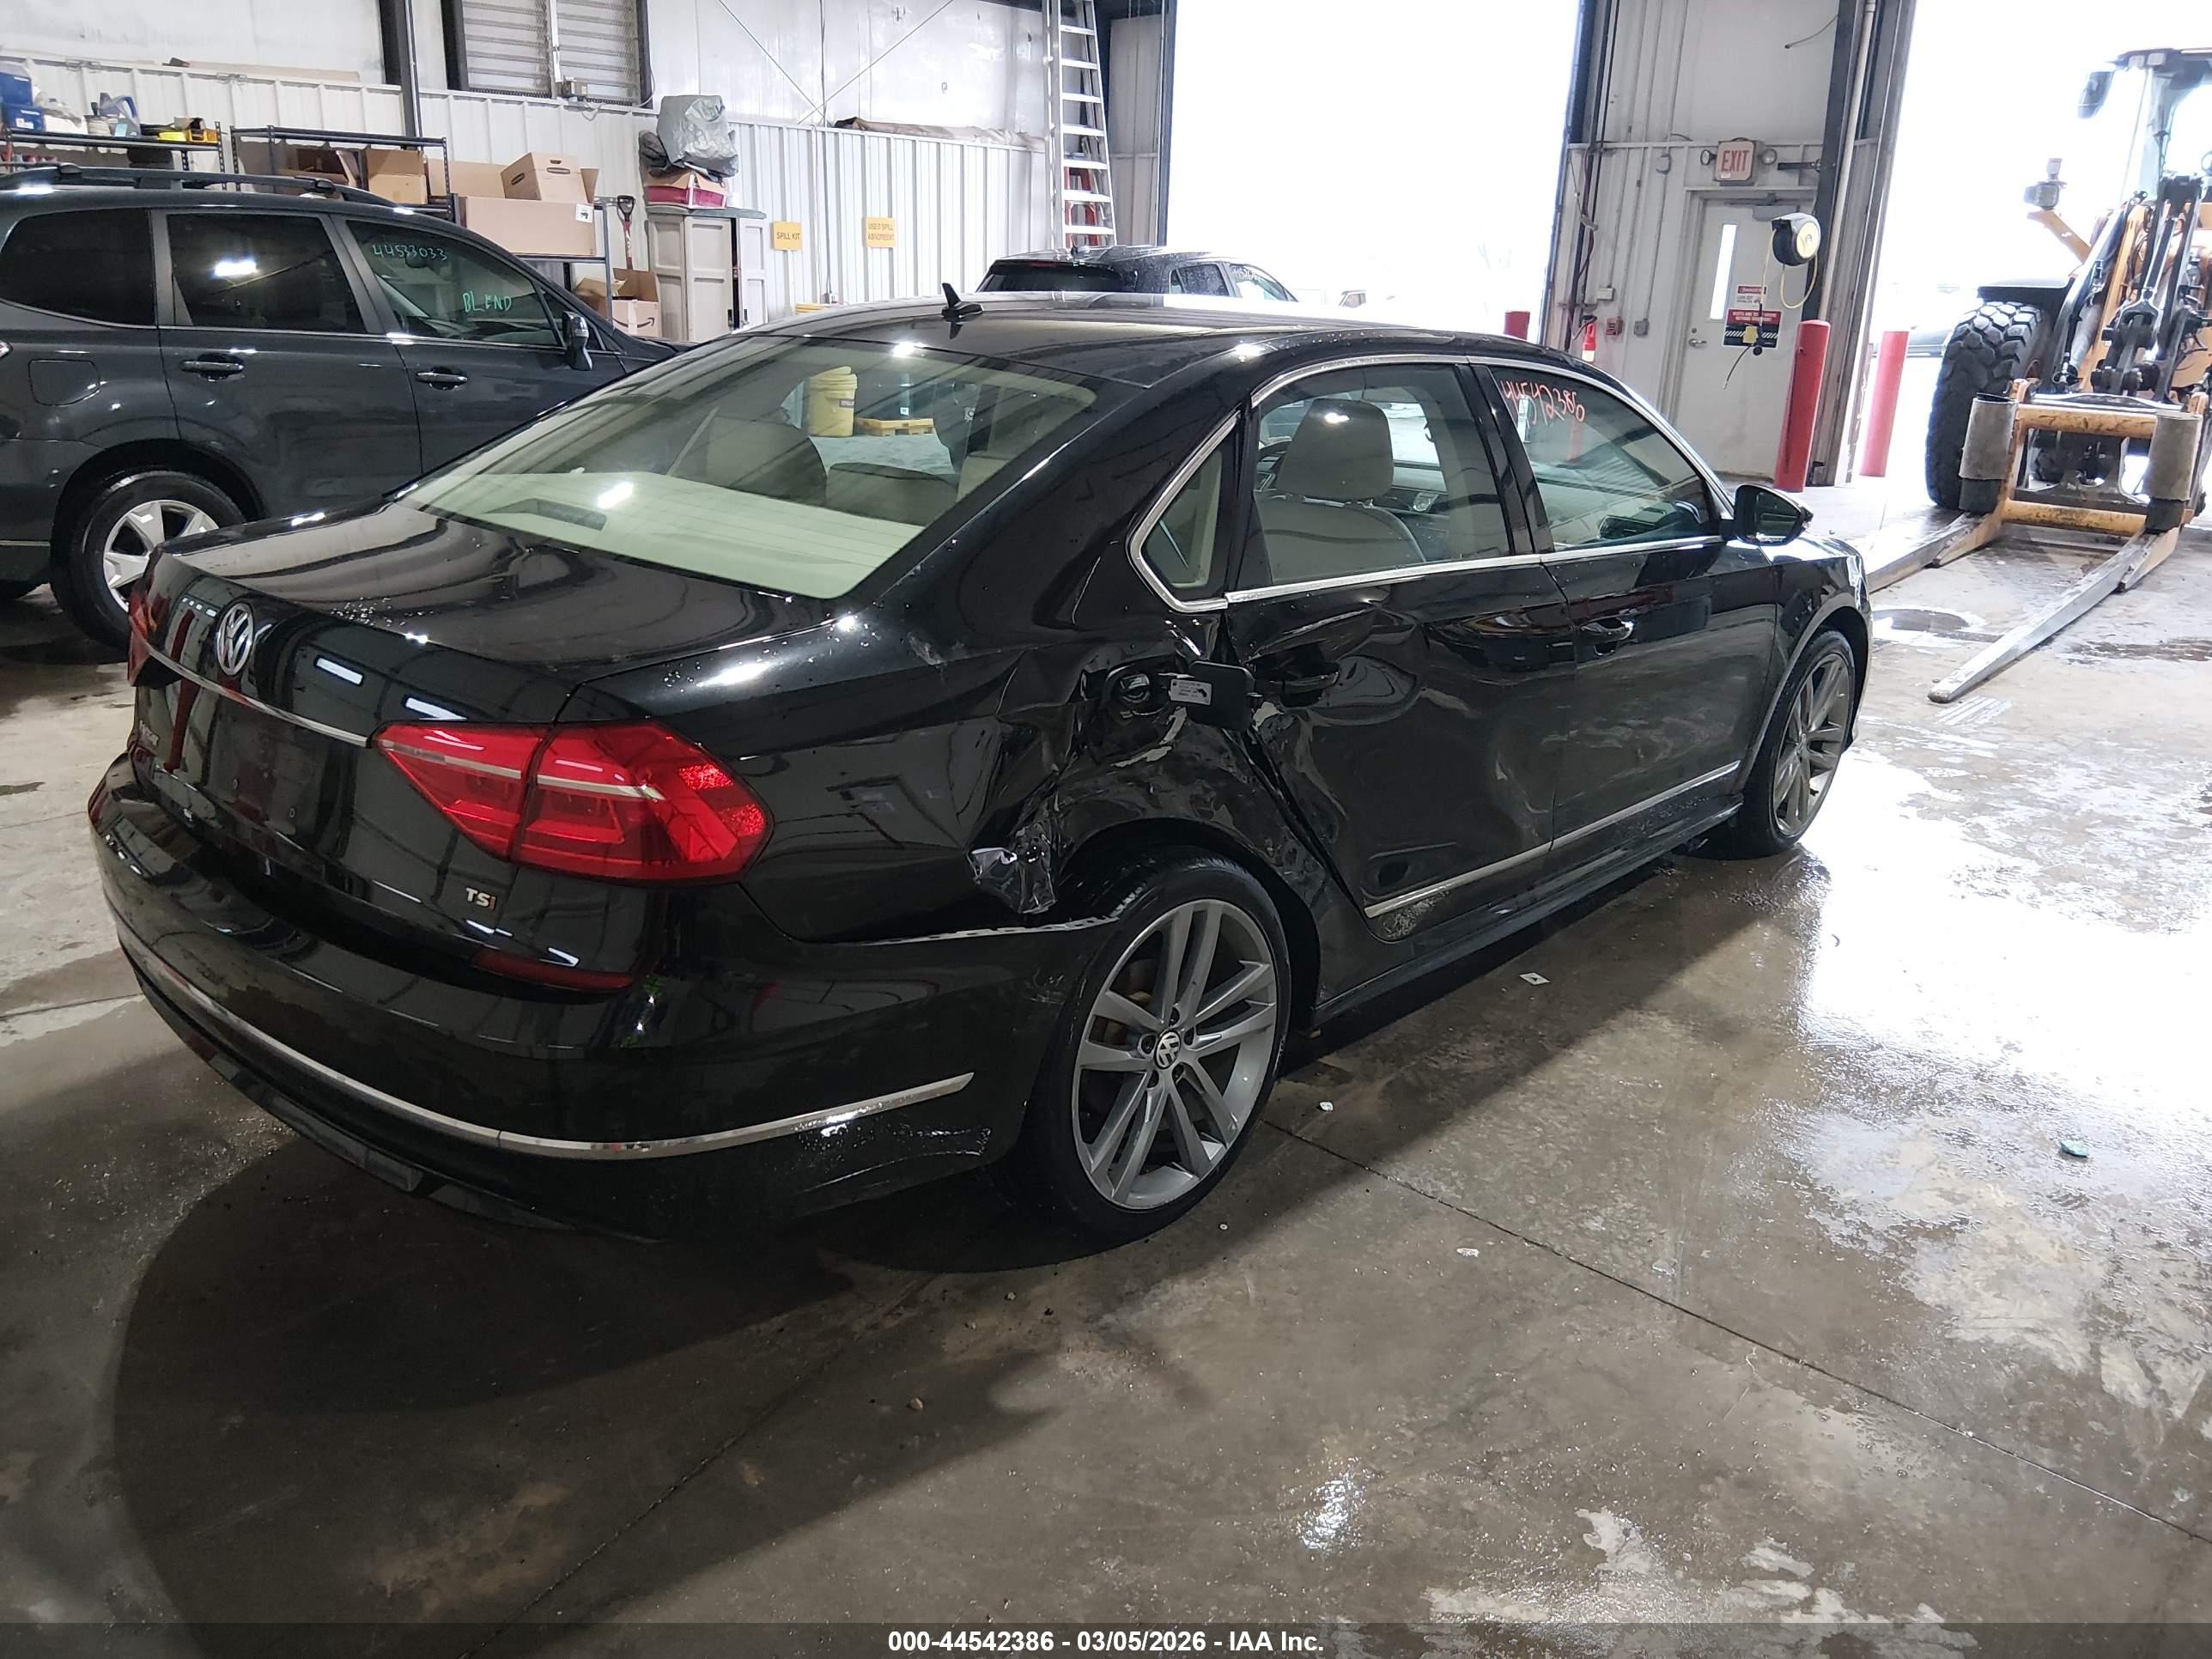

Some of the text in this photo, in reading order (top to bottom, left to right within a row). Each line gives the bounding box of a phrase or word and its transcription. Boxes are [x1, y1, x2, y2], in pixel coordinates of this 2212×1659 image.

[1721, 149, 1750, 173] EXIT
[776, 232, 791, 240] SPILL
[372, 244, 447, 261] 44533033
[462, 289, 513, 313] BLEND
[1499, 380, 1585, 429] 44542386
